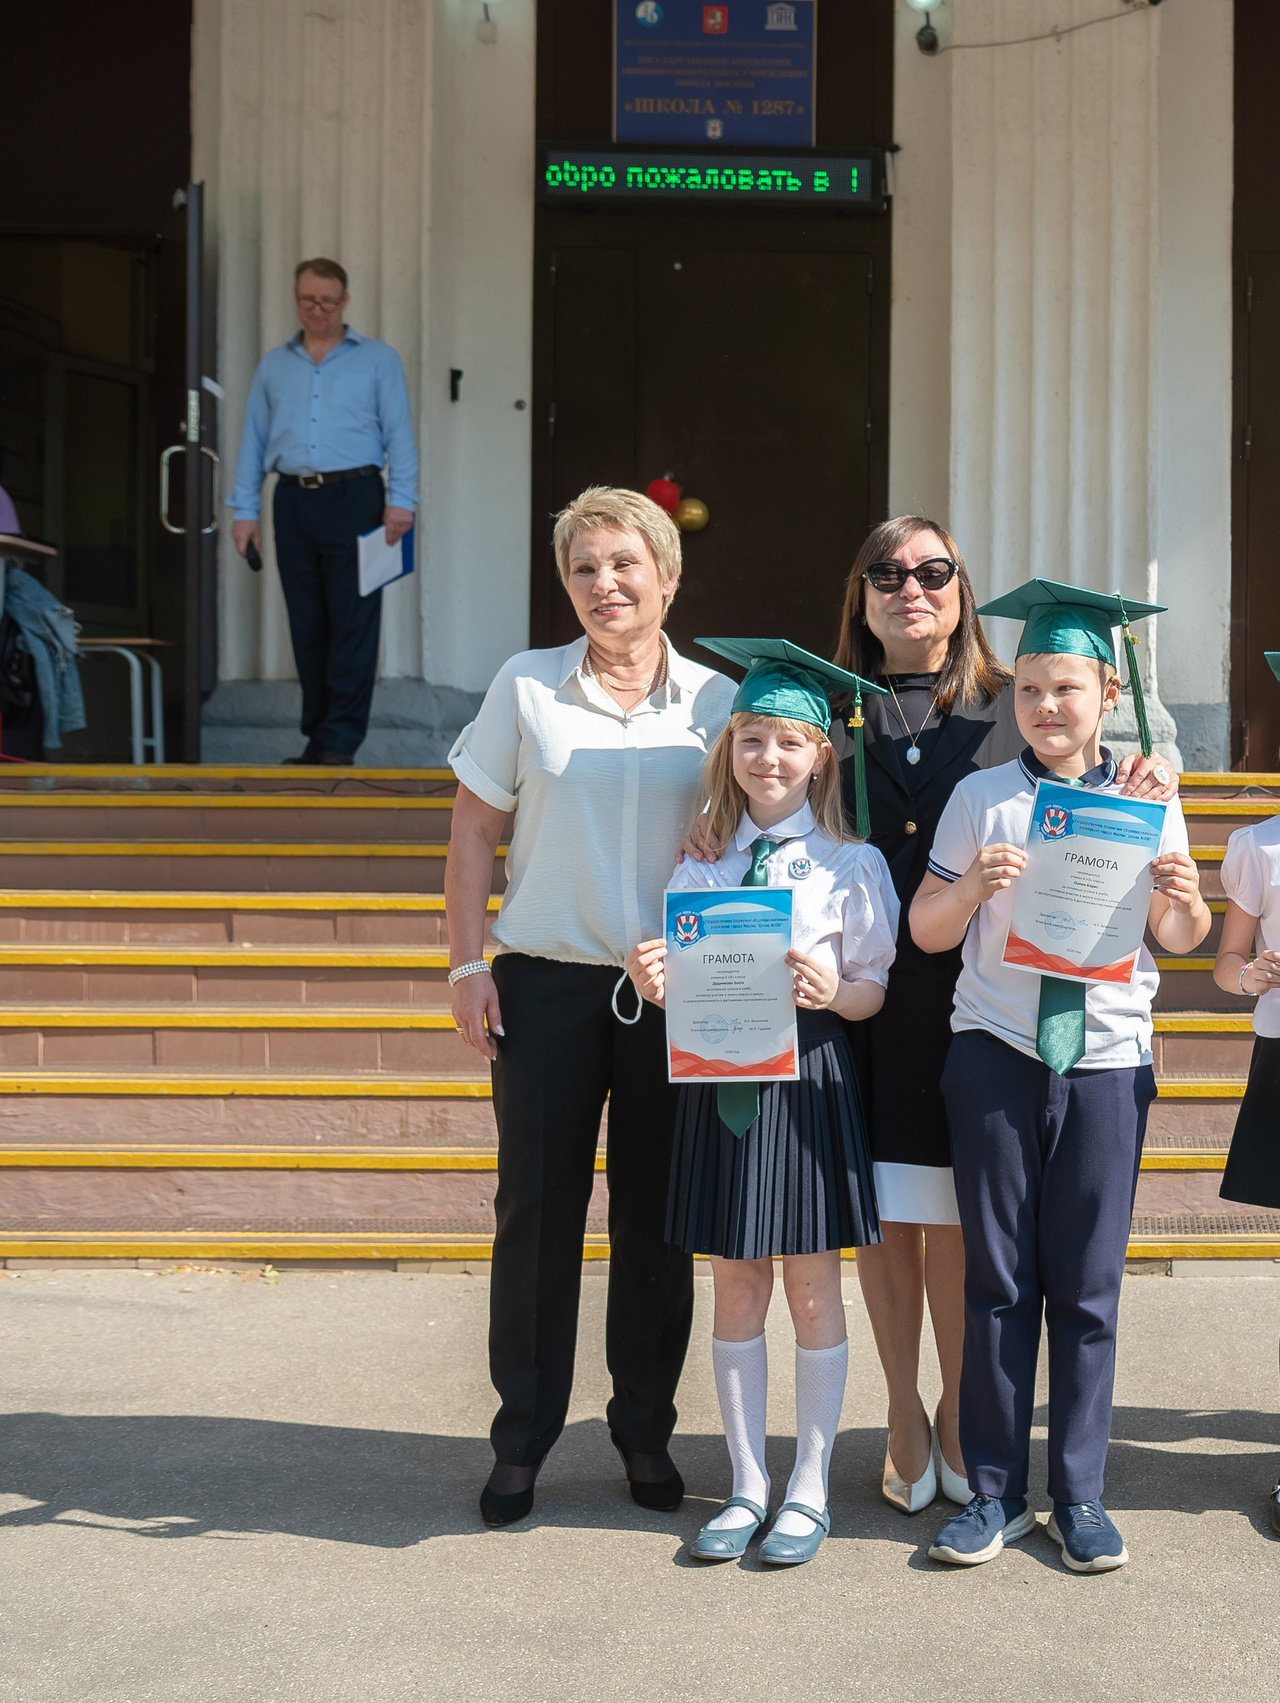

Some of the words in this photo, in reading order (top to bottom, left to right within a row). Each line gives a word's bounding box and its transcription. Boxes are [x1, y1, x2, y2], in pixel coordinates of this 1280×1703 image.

[624, 97, 715, 114] «ШКОЛА
[723, 99, 743, 115] №
[627, 166, 802, 191] пожаловать
[1064, 852, 1119, 870] ГРАМОТА
[703, 954, 754, 964] ГРАМОТА
